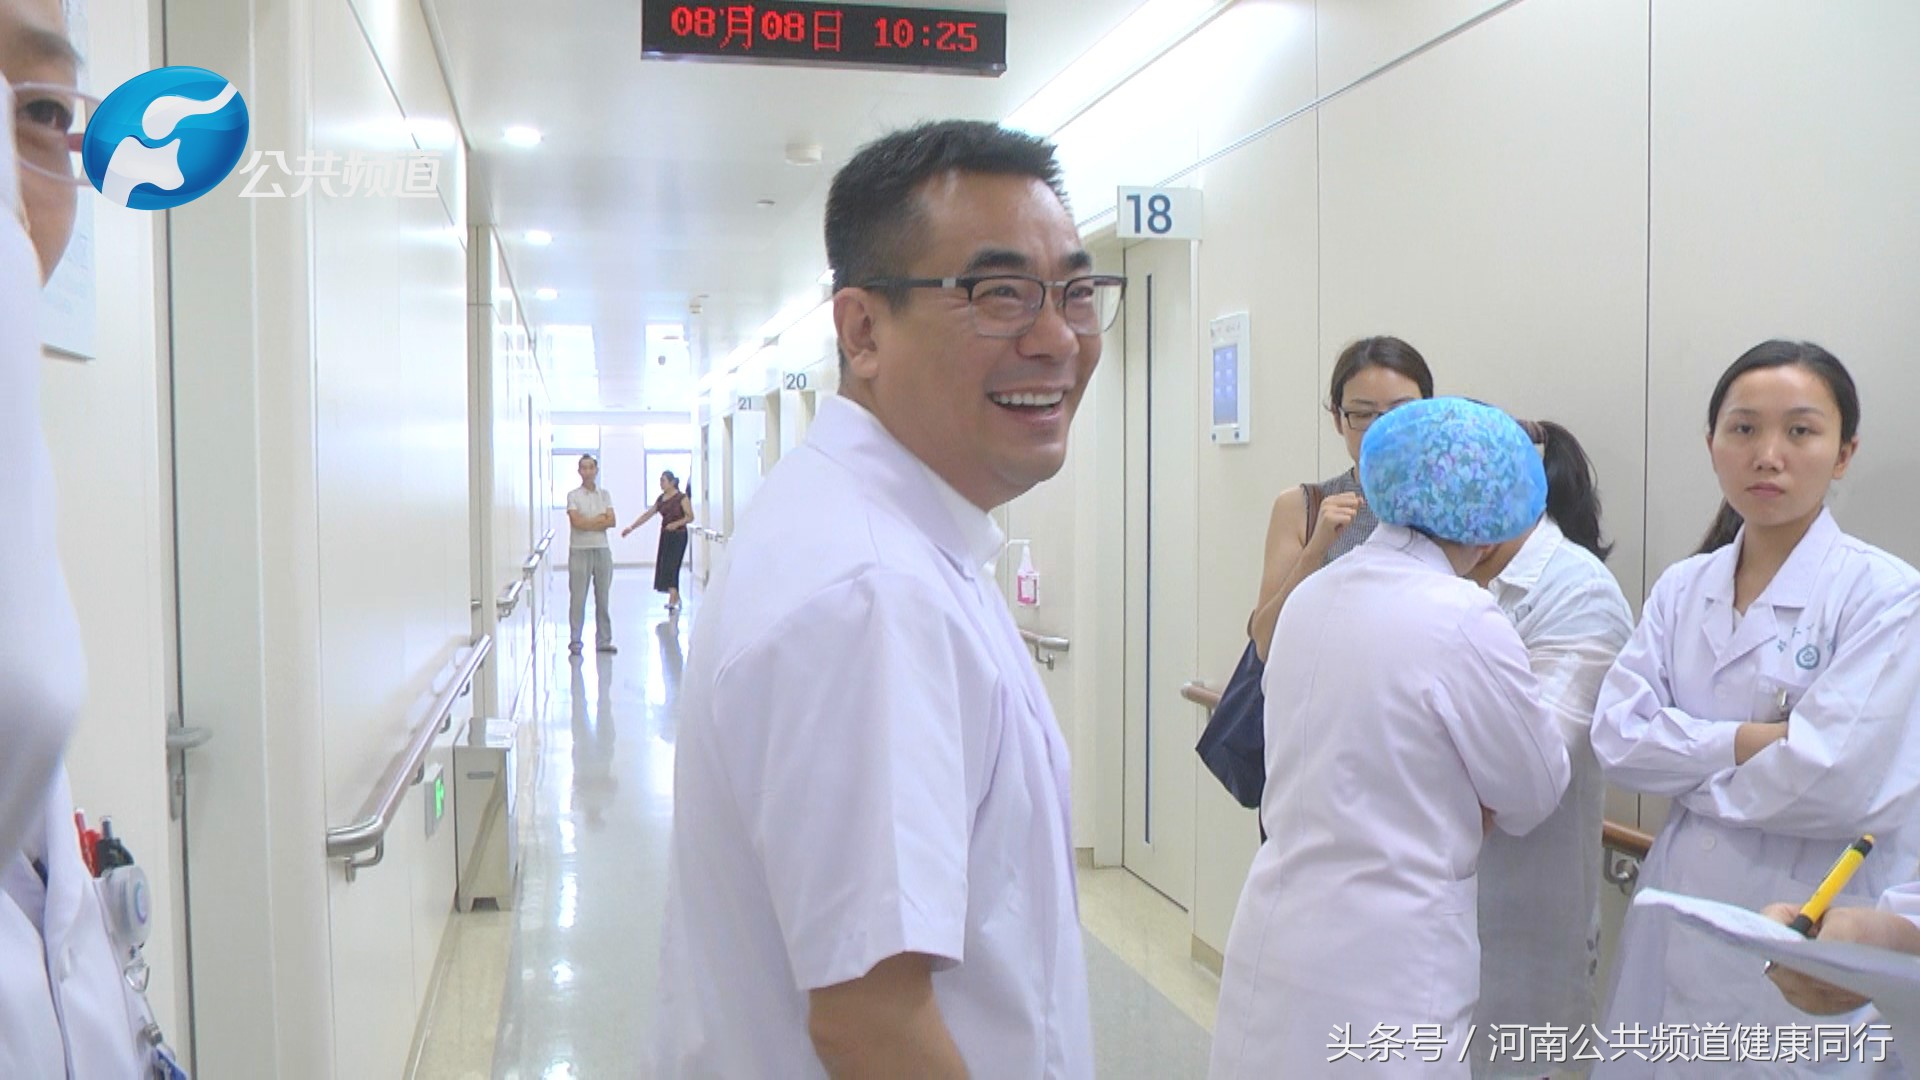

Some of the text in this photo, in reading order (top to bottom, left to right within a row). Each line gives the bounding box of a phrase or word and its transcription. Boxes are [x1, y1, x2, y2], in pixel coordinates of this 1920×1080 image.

[671, 5, 978, 53] 08月08日 10:25
[1126, 194, 1172, 234] 18
[785, 373, 807, 390] 20
[738, 397, 751, 410] 21
